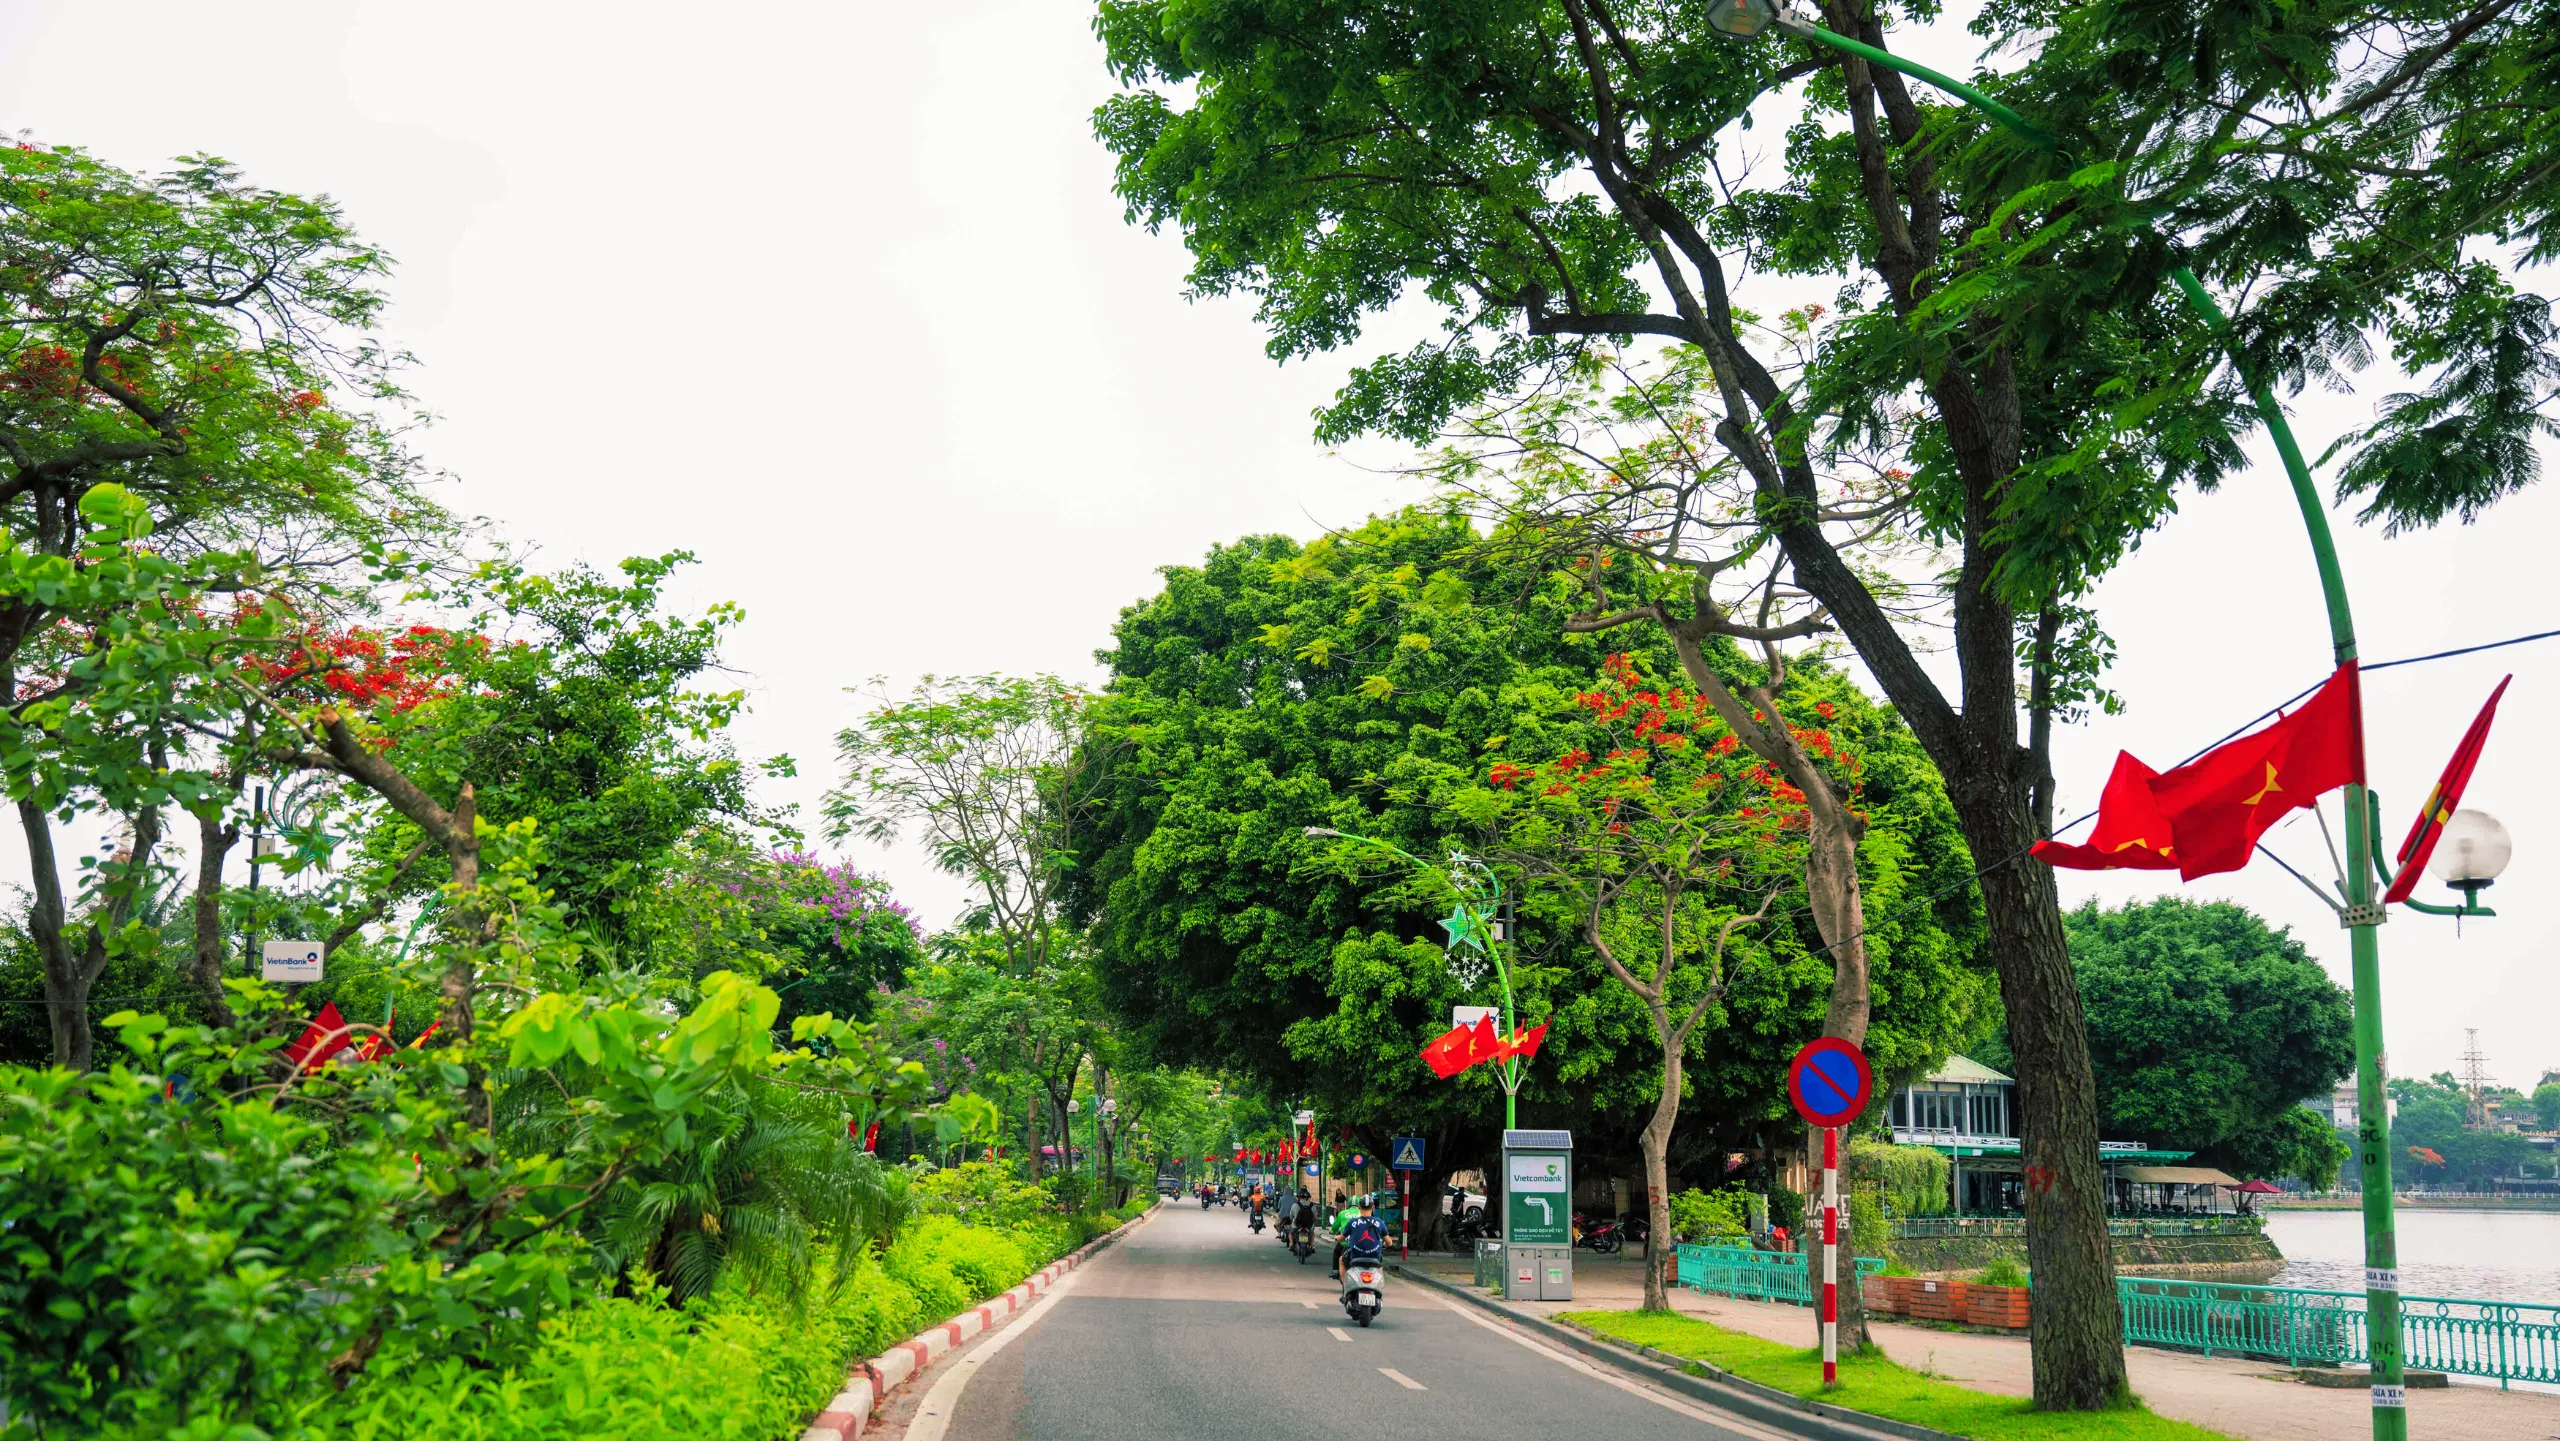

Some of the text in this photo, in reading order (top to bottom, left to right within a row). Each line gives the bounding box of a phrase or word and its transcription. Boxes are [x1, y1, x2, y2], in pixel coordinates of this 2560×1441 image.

[266, 957, 307, 965] VietinBank
[1513, 1174, 1562, 1182] Vietcombank
[2387, 1389, 2397, 1398] XE
